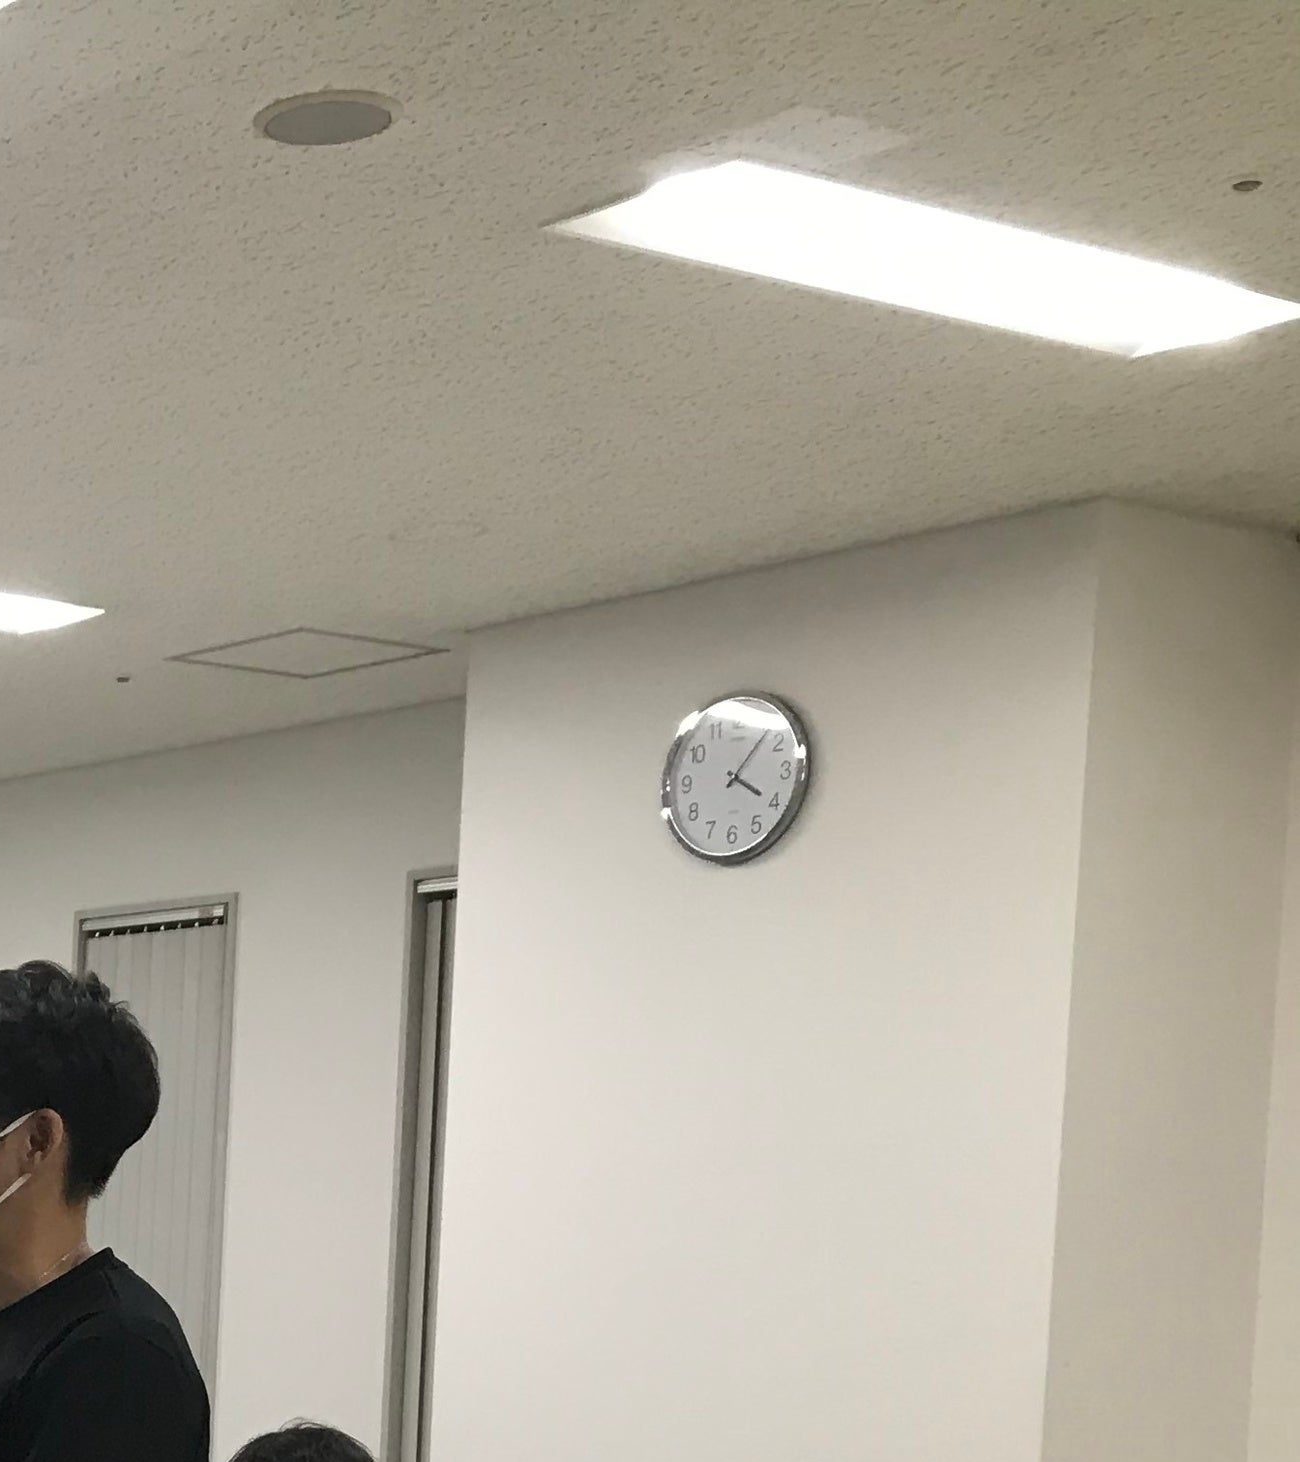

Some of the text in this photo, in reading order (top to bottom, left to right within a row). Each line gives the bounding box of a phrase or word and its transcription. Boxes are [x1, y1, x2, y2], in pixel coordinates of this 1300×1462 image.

[709, 721, 722, 740] 11
[772, 733, 784, 752] 2
[690, 744, 706, 763] 10
[780, 760, 791, 780] 3
[681, 775, 692, 794] 9
[768, 792, 780, 810] 4
[688, 802, 699, 821] 8
[705, 820, 716, 839] 7
[751, 815, 762, 834] 5
[726, 825, 738, 844] 6
